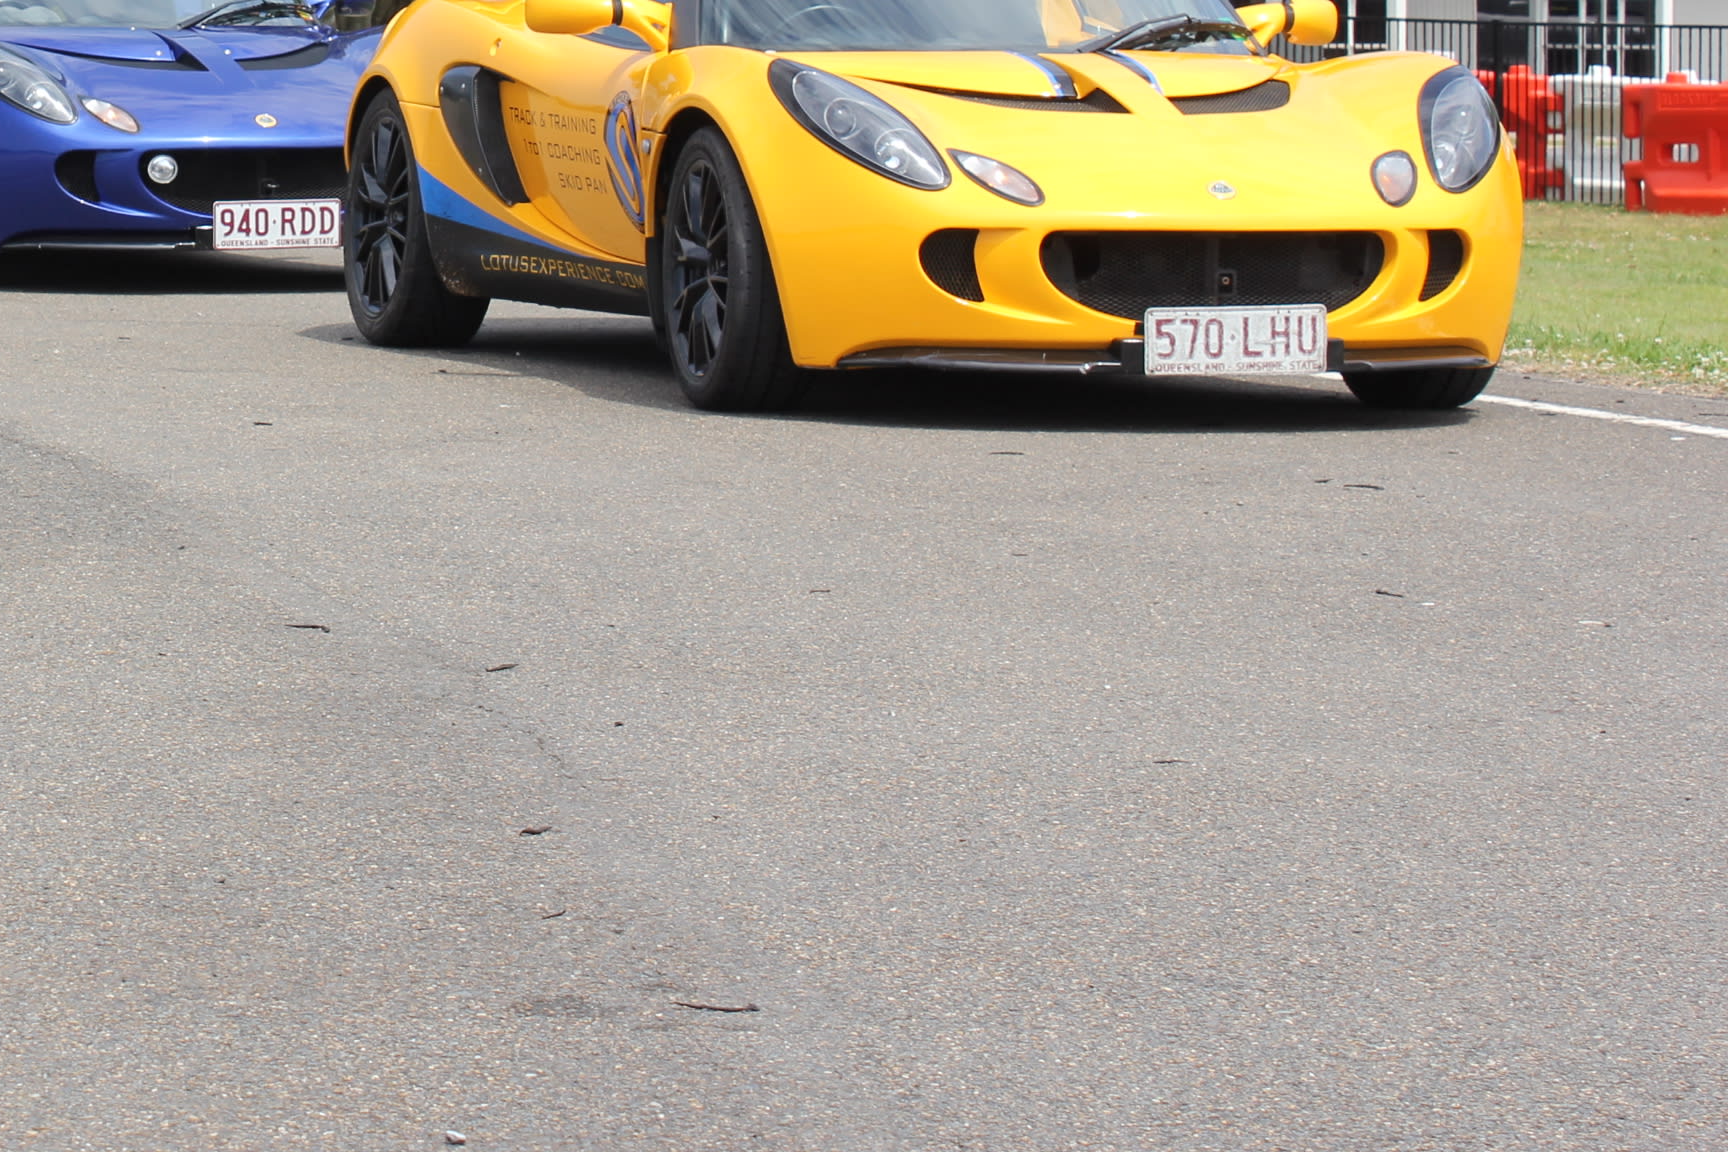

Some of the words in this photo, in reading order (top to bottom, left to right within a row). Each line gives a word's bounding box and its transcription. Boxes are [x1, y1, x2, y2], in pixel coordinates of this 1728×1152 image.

[508, 106, 537, 127] TRACK
[548, 113, 597, 135] TRAINING
[547, 142, 601, 165] COACHING
[558, 172, 583, 191] SKID
[586, 176, 608, 195] PAN
[220, 239, 269, 247] QUEENSLAND
[275, 238, 310, 246] SUNSHINE
[314, 237, 334, 245] STATE
[1154, 362, 1226, 373] QUEENSLAND
[1235, 361, 1284, 372] SUNSHINE
[1289, 360, 1318, 371] STATE
